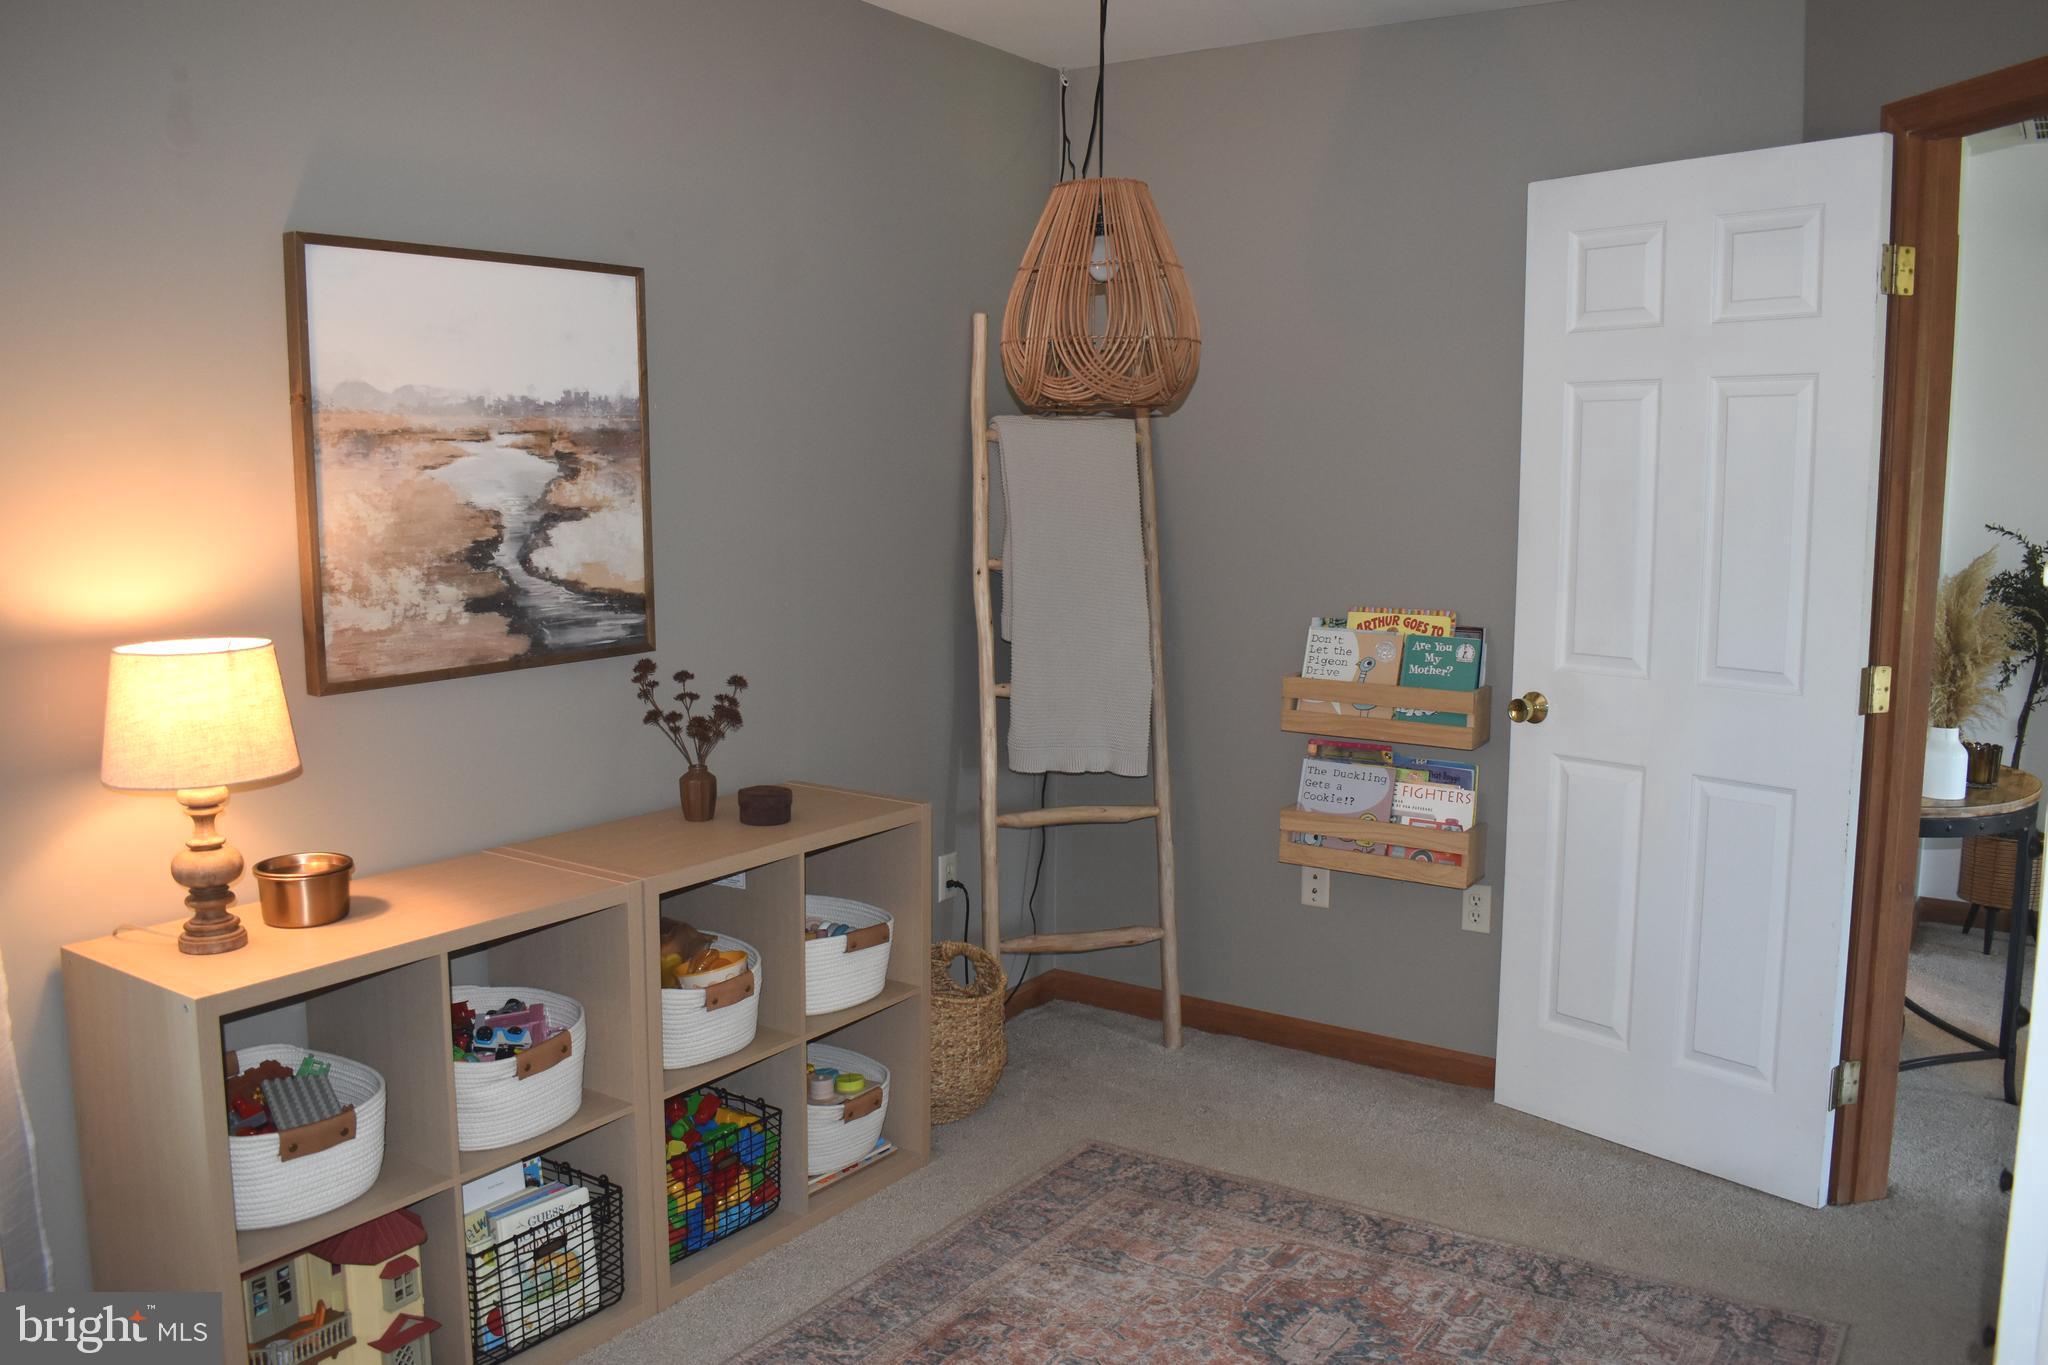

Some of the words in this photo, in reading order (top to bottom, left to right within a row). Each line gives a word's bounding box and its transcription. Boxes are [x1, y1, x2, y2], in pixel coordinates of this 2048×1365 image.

[1356, 615, 1400, 631] ARTHUR
[1402, 616, 1430, 634] GOES
[1431, 625, 1444, 637] TO
[1311, 634, 1344, 645] Don't
[1309, 644, 1329, 655] Let
[1334, 646, 1353, 656] the
[1412, 641, 1432, 652] Are
[1435, 642, 1453, 652] You
[1307, 655, 1348, 667] Pigeon
[1424, 652, 1442, 665] My
[1306, 665, 1341, 677] Drive
[1408, 664, 1454, 677] Mother?
[1307, 765, 1328, 776] The
[1333, 768, 1388, 786] Duckling
[1304, 778, 1331, 790] Gets
[1336, 783, 1343, 791] a
[1303, 791, 1356, 806] Cookie!?
[1402, 784, 1472, 805] FIGHTERS
[527, 1204, 565, 1227] GUESS
